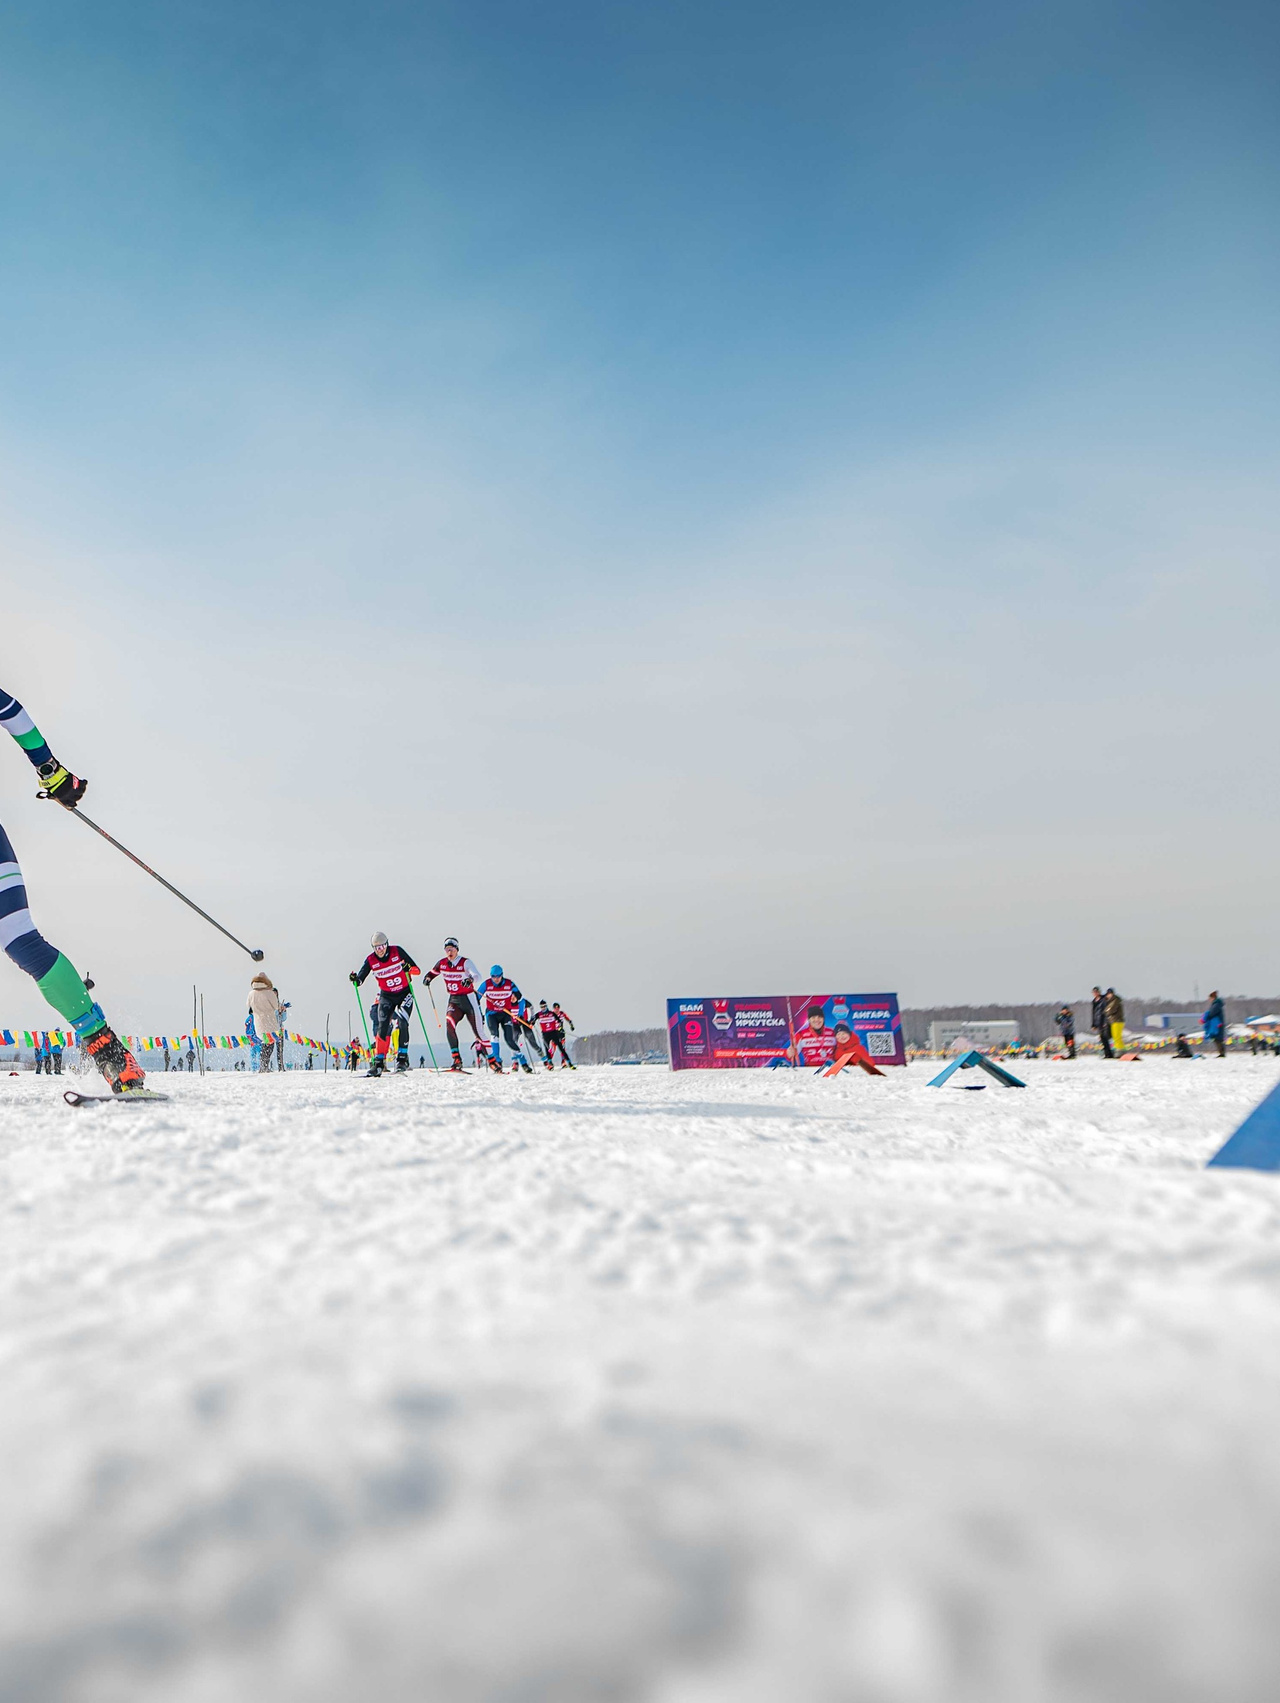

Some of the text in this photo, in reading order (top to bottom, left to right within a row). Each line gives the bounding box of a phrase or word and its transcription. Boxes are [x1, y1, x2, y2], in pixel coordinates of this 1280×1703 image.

[386, 977, 402, 987] 89
[679, 1004, 703, 1012] БАМ
[735, 1011, 773, 1019] ЛЫЖНЯ
[852, 1010, 891, 1020] АНГАРА
[735, 1018, 786, 1027] ИРКУТСКА
[685, 1020, 701, 1039] 9
